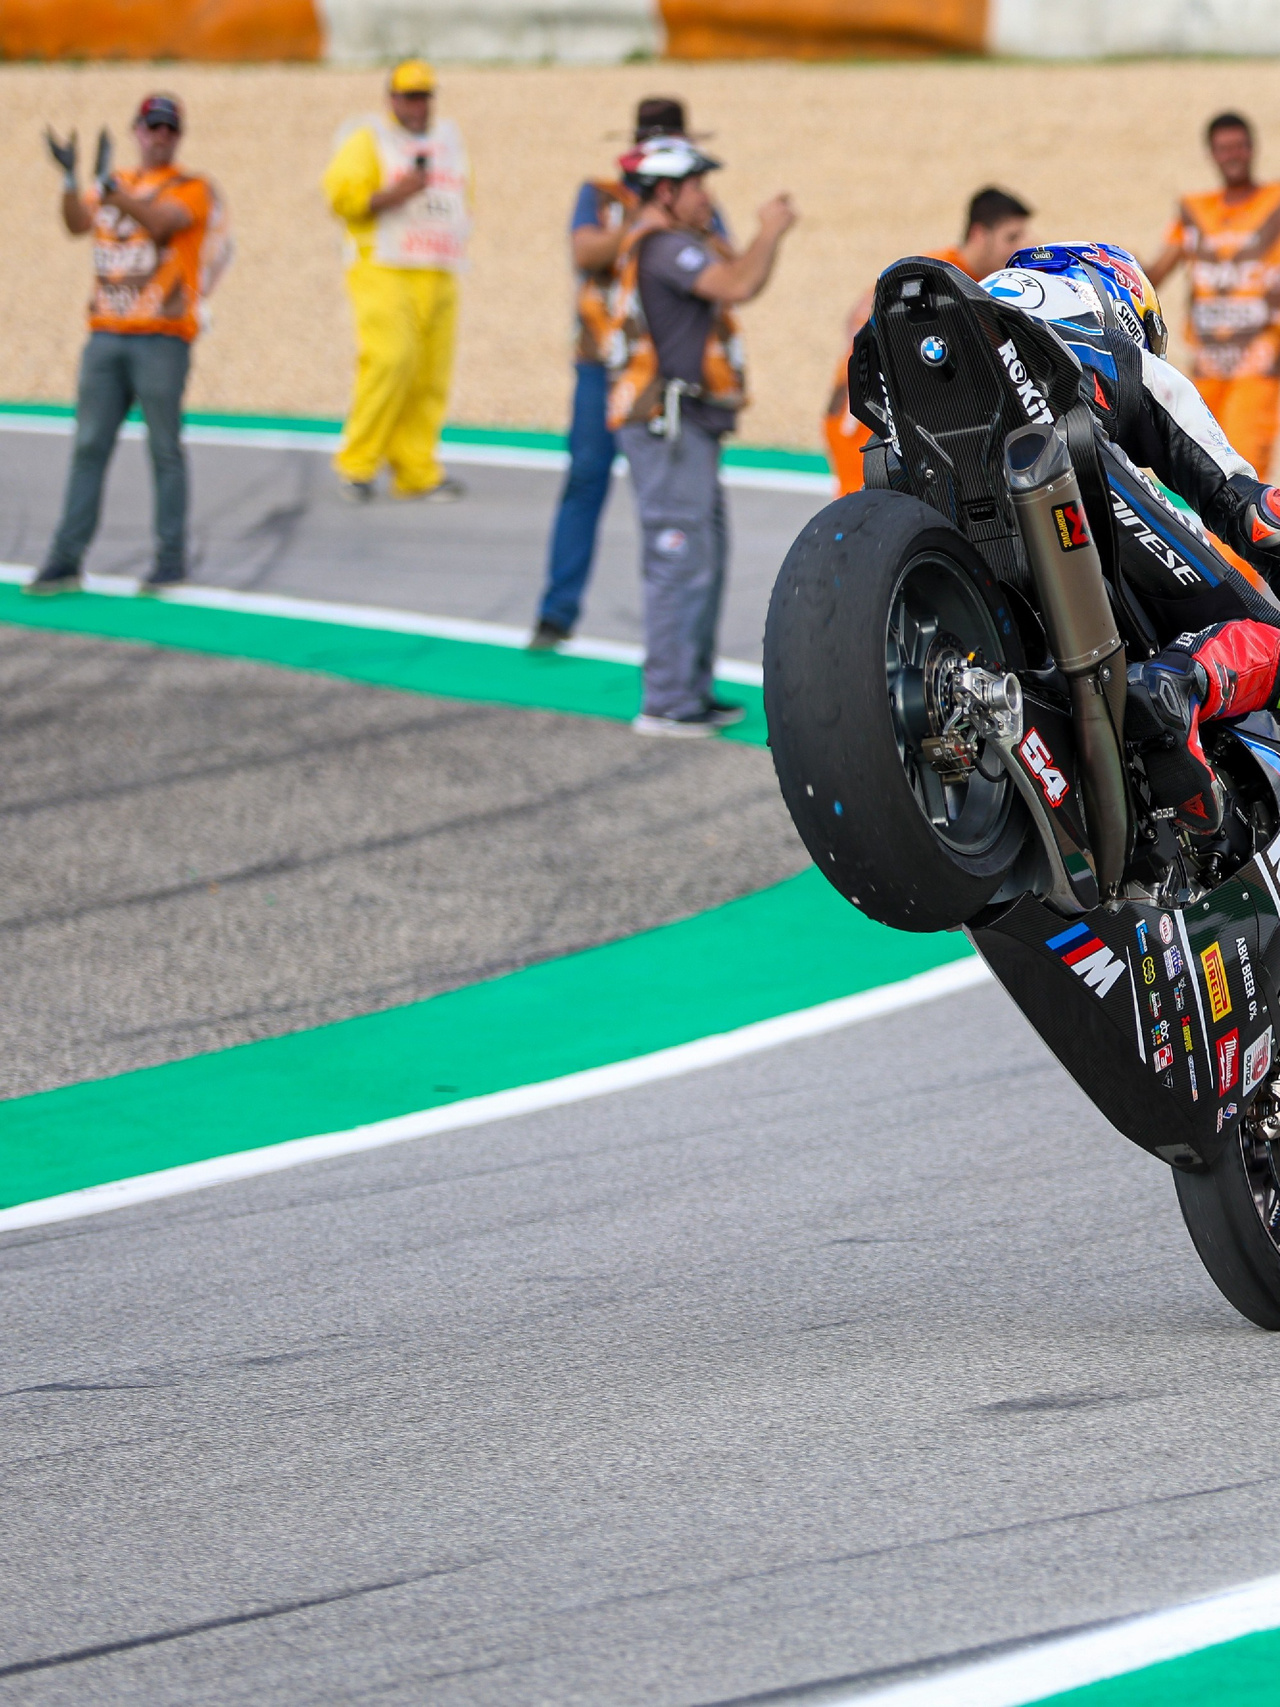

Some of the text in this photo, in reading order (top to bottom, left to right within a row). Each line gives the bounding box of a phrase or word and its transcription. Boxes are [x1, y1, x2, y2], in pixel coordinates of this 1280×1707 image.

[1117, 305, 1142, 344] SHOEI
[1110, 490, 1202, 586] AINESE
[1020, 728, 1069, 806] 54
[1071, 946, 1127, 999] M
[1205, 949, 1228, 1015] PIRELLI
[1235, 936, 1258, 1021] ABK BEER 0%
[1160, 1020, 1170, 1042] ebc
[1224, 1036, 1238, 1088] Milwaukee
